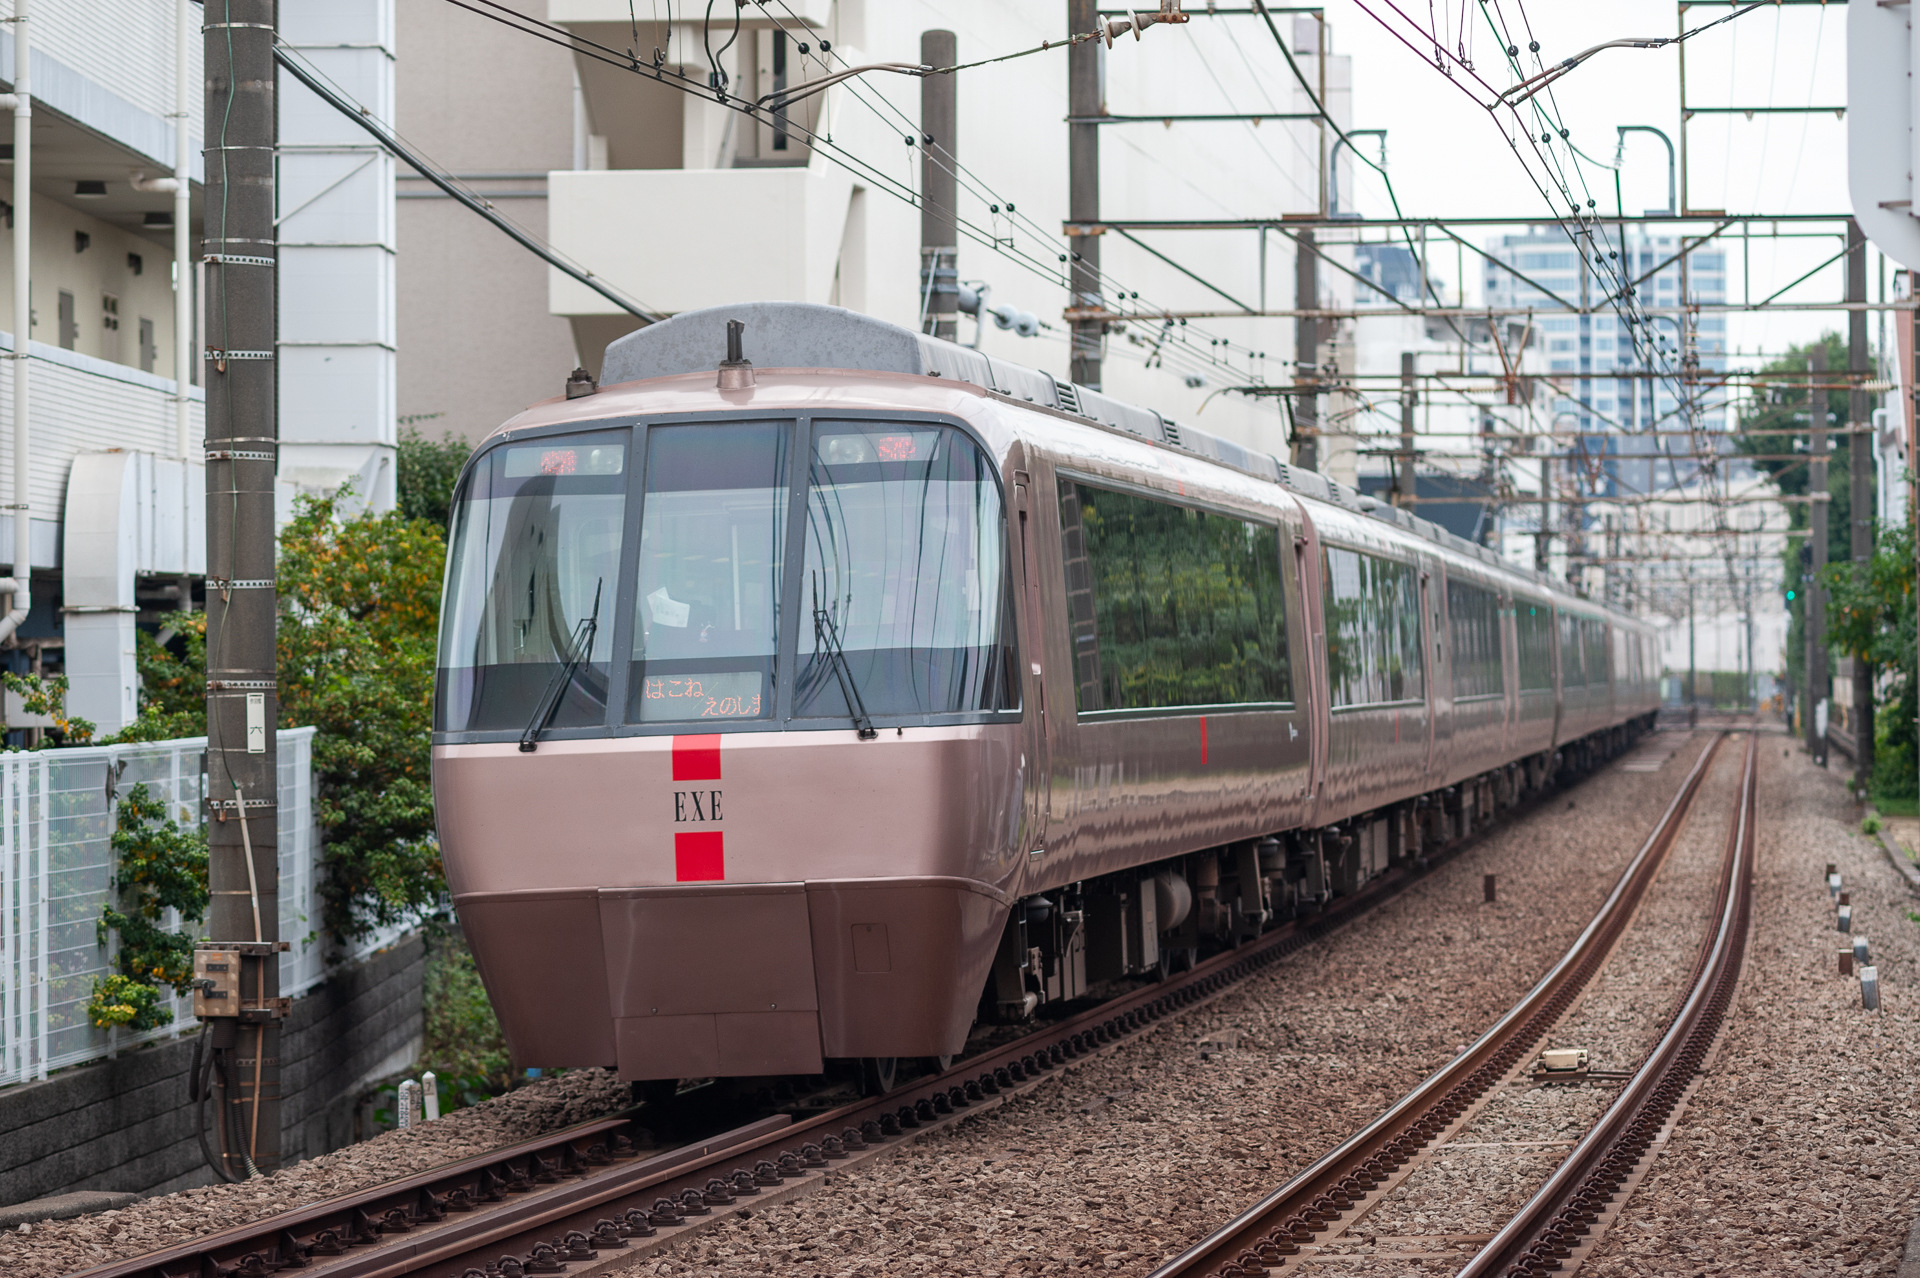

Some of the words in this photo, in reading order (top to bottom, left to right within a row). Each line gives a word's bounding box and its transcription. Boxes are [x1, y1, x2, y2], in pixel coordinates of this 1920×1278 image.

[701, 694, 762, 717] えのしま
[673, 790, 723, 822] EXE
